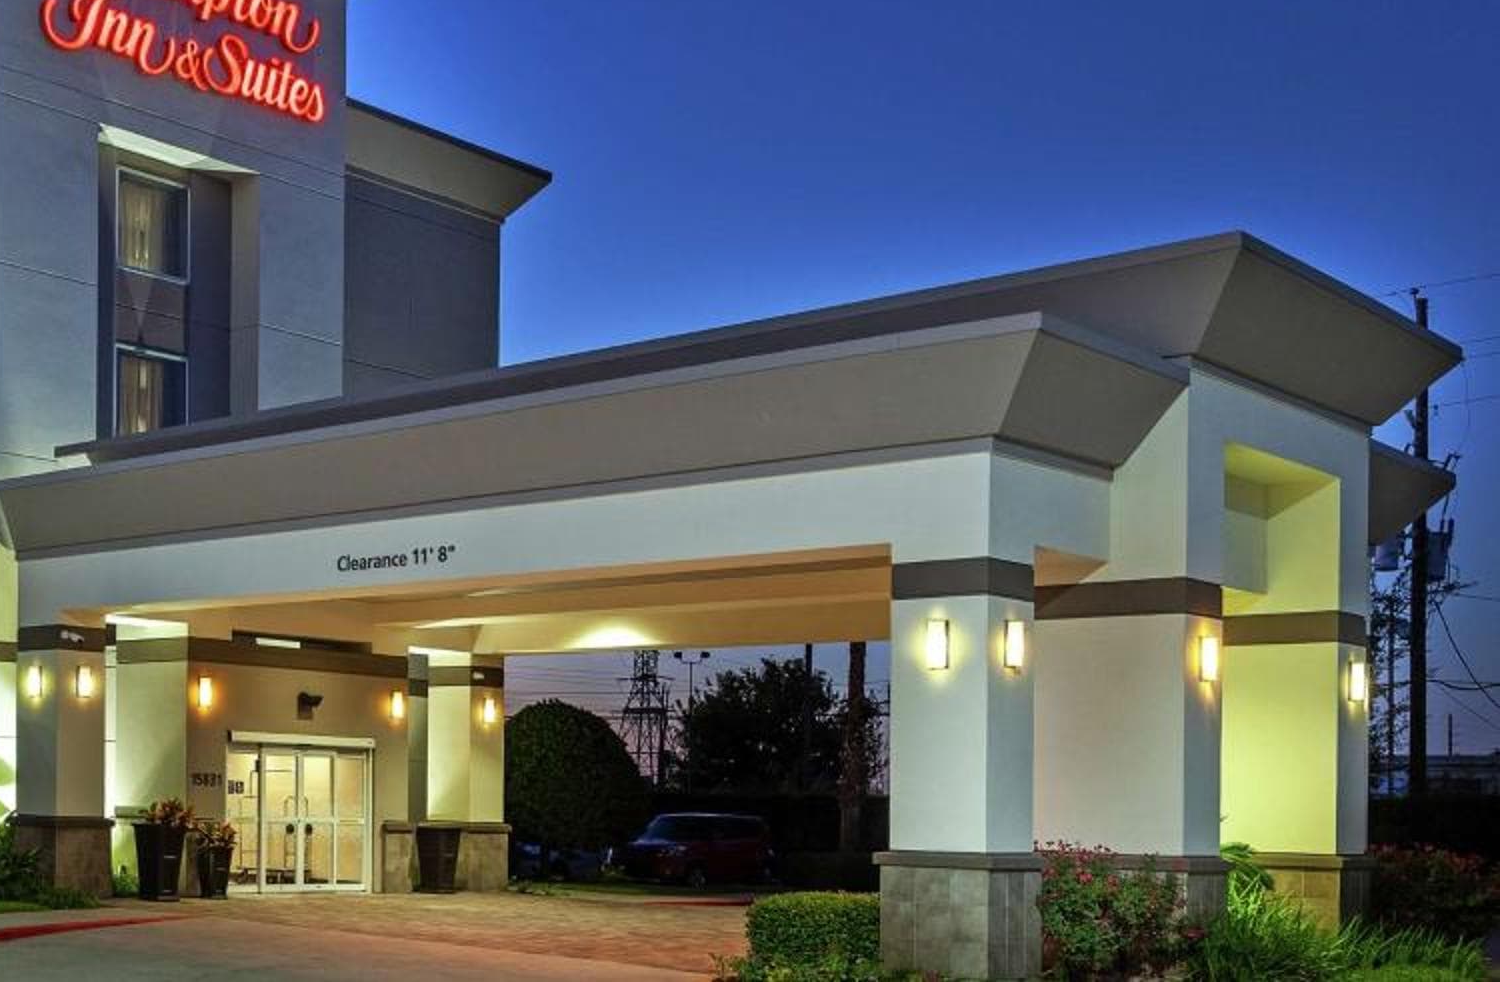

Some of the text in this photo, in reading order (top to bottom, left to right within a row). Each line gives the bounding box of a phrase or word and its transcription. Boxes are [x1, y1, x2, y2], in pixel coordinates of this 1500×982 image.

[174, 37, 209, 92] &
[203, 32, 326, 124] Suites
[337, 544, 456, 572] Clearance 11' 8"
